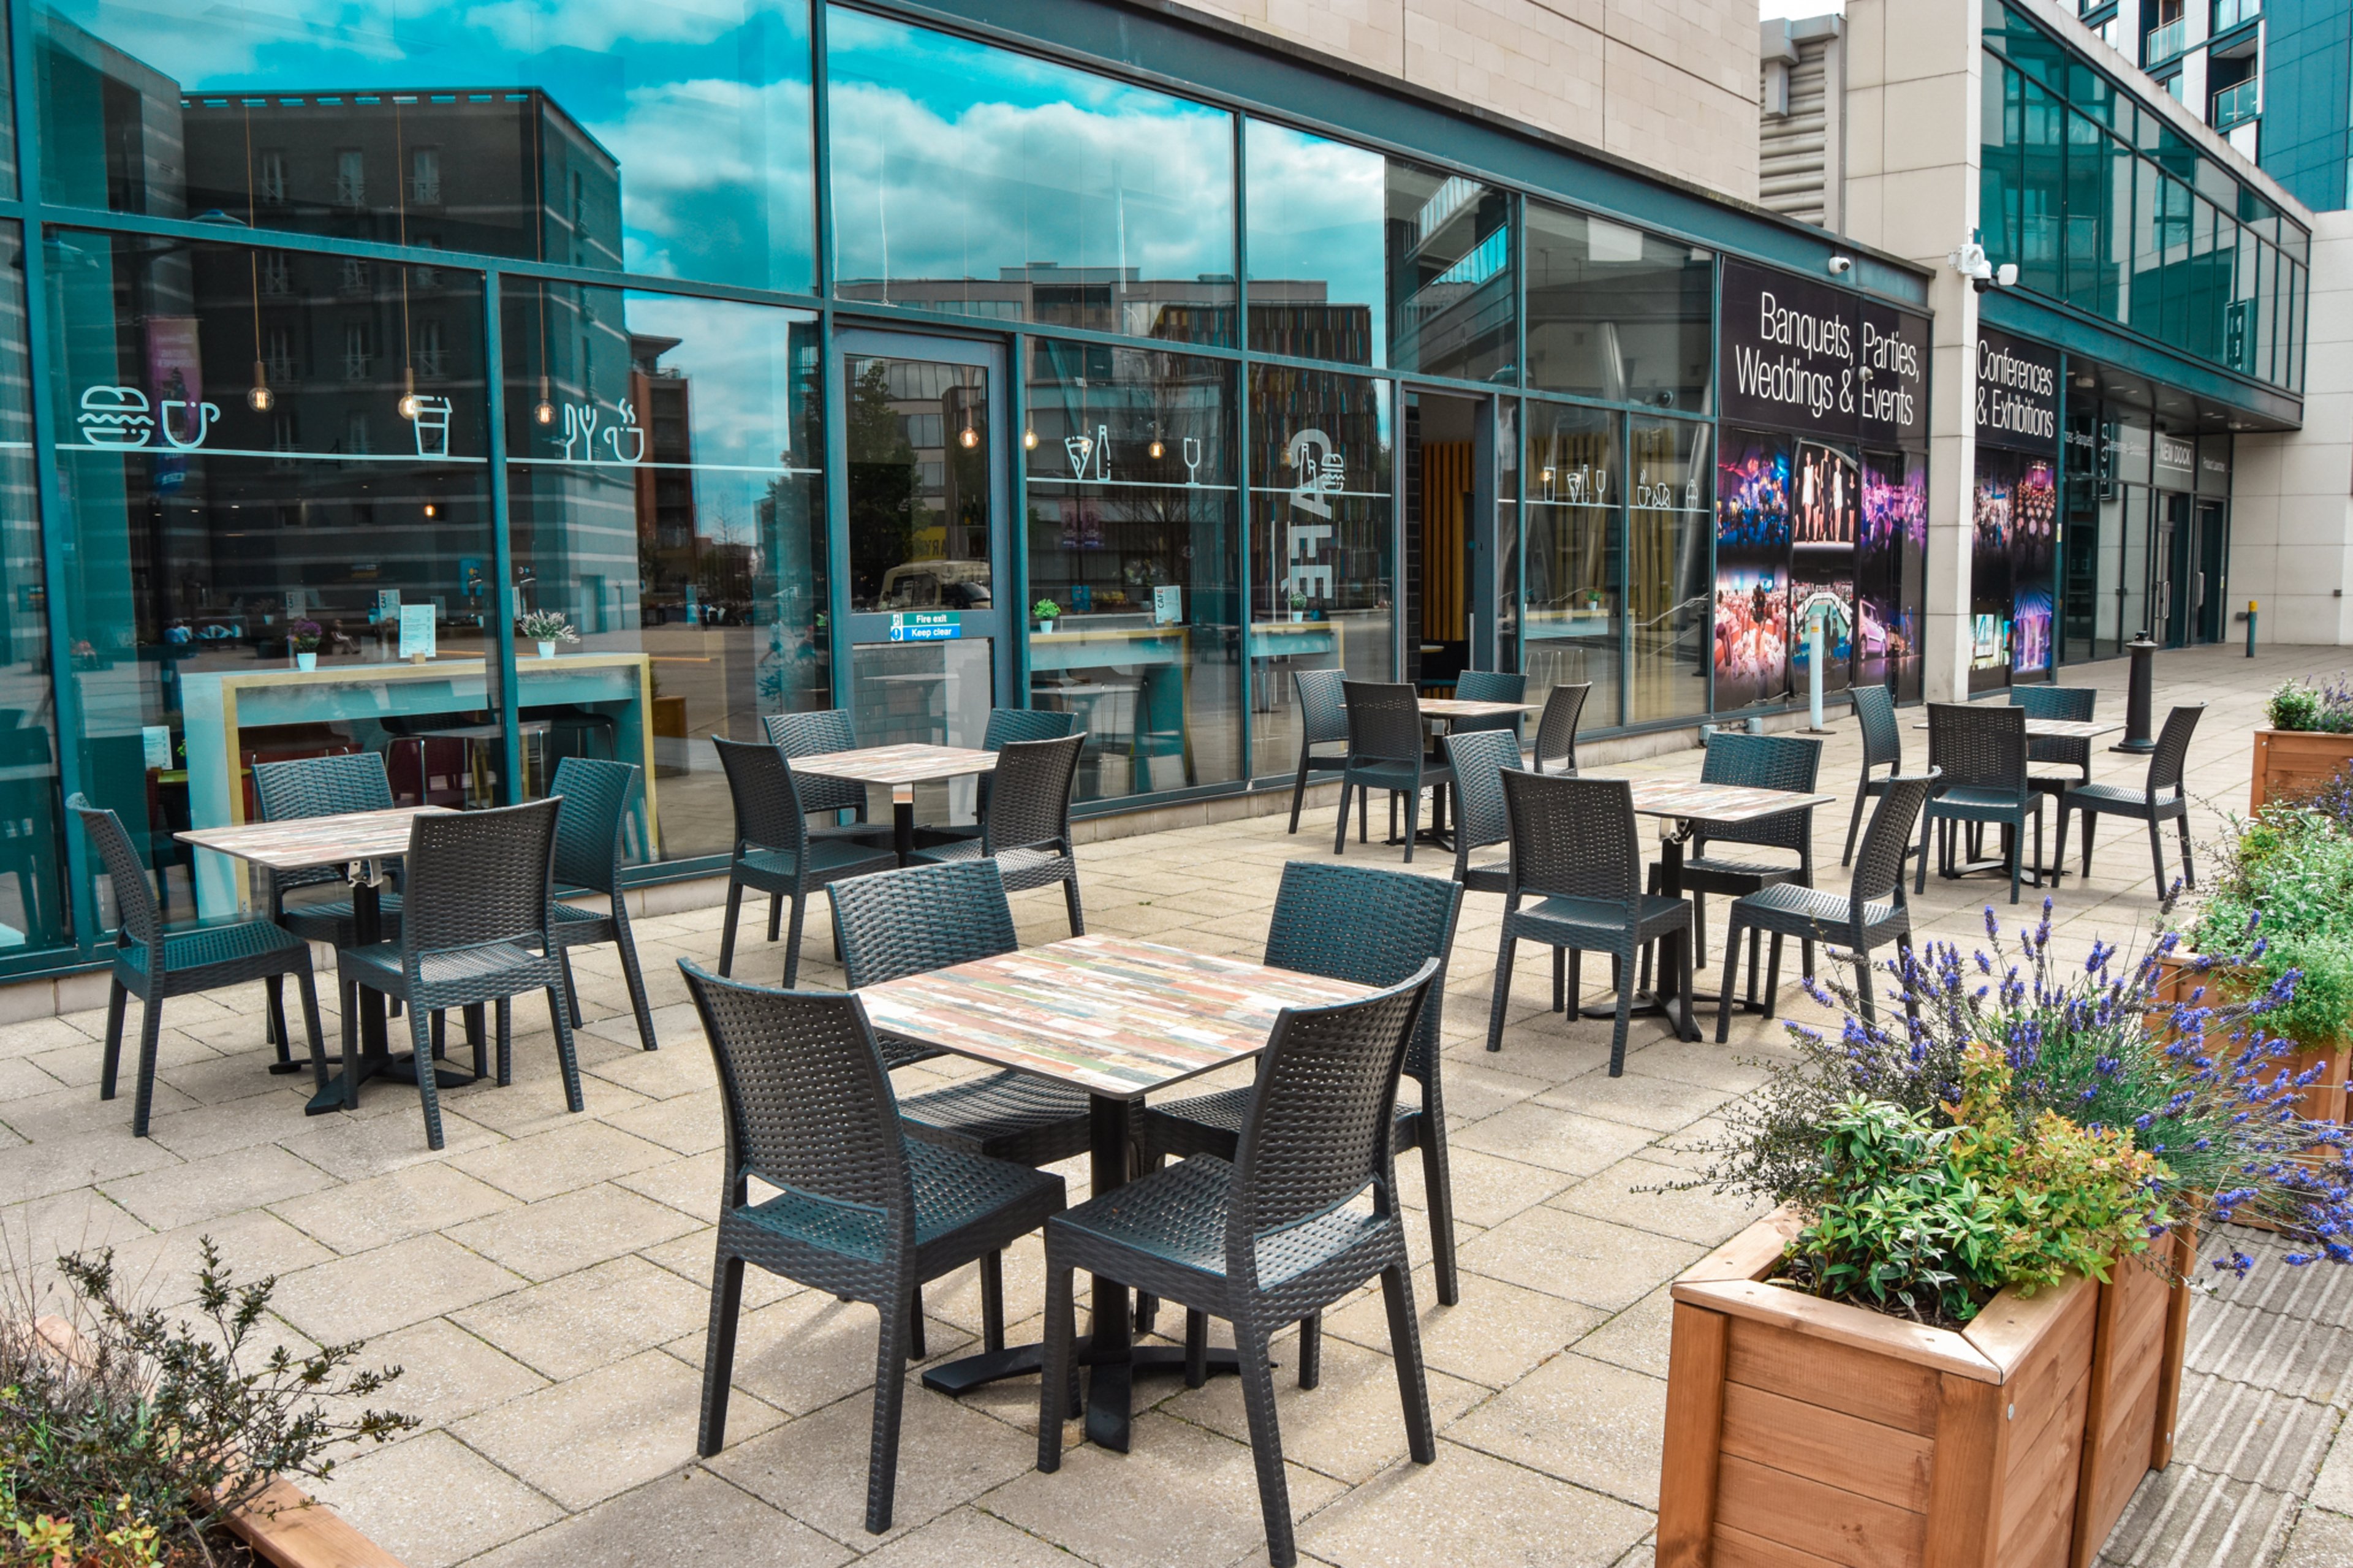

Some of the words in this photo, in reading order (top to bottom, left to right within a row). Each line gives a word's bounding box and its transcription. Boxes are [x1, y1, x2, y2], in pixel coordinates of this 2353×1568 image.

[1760, 291, 1854, 366] Banquets,
[1863, 322, 1919, 384] Parties,
[1735, 344, 1834, 418] Weddings
[1839, 369, 1855, 414] &
[1862, 381, 1914, 426] Events
[1977, 339, 2053, 396] Conferences
[1976, 386, 1988, 425] &
[1992, 392, 2054, 439] Exhibitions
[2159, 442, 2173, 463] NEW
[2174, 445, 2191, 466] DOCK
[912, 628, 931, 637] Keep
[916, 615, 931, 623] Fire
